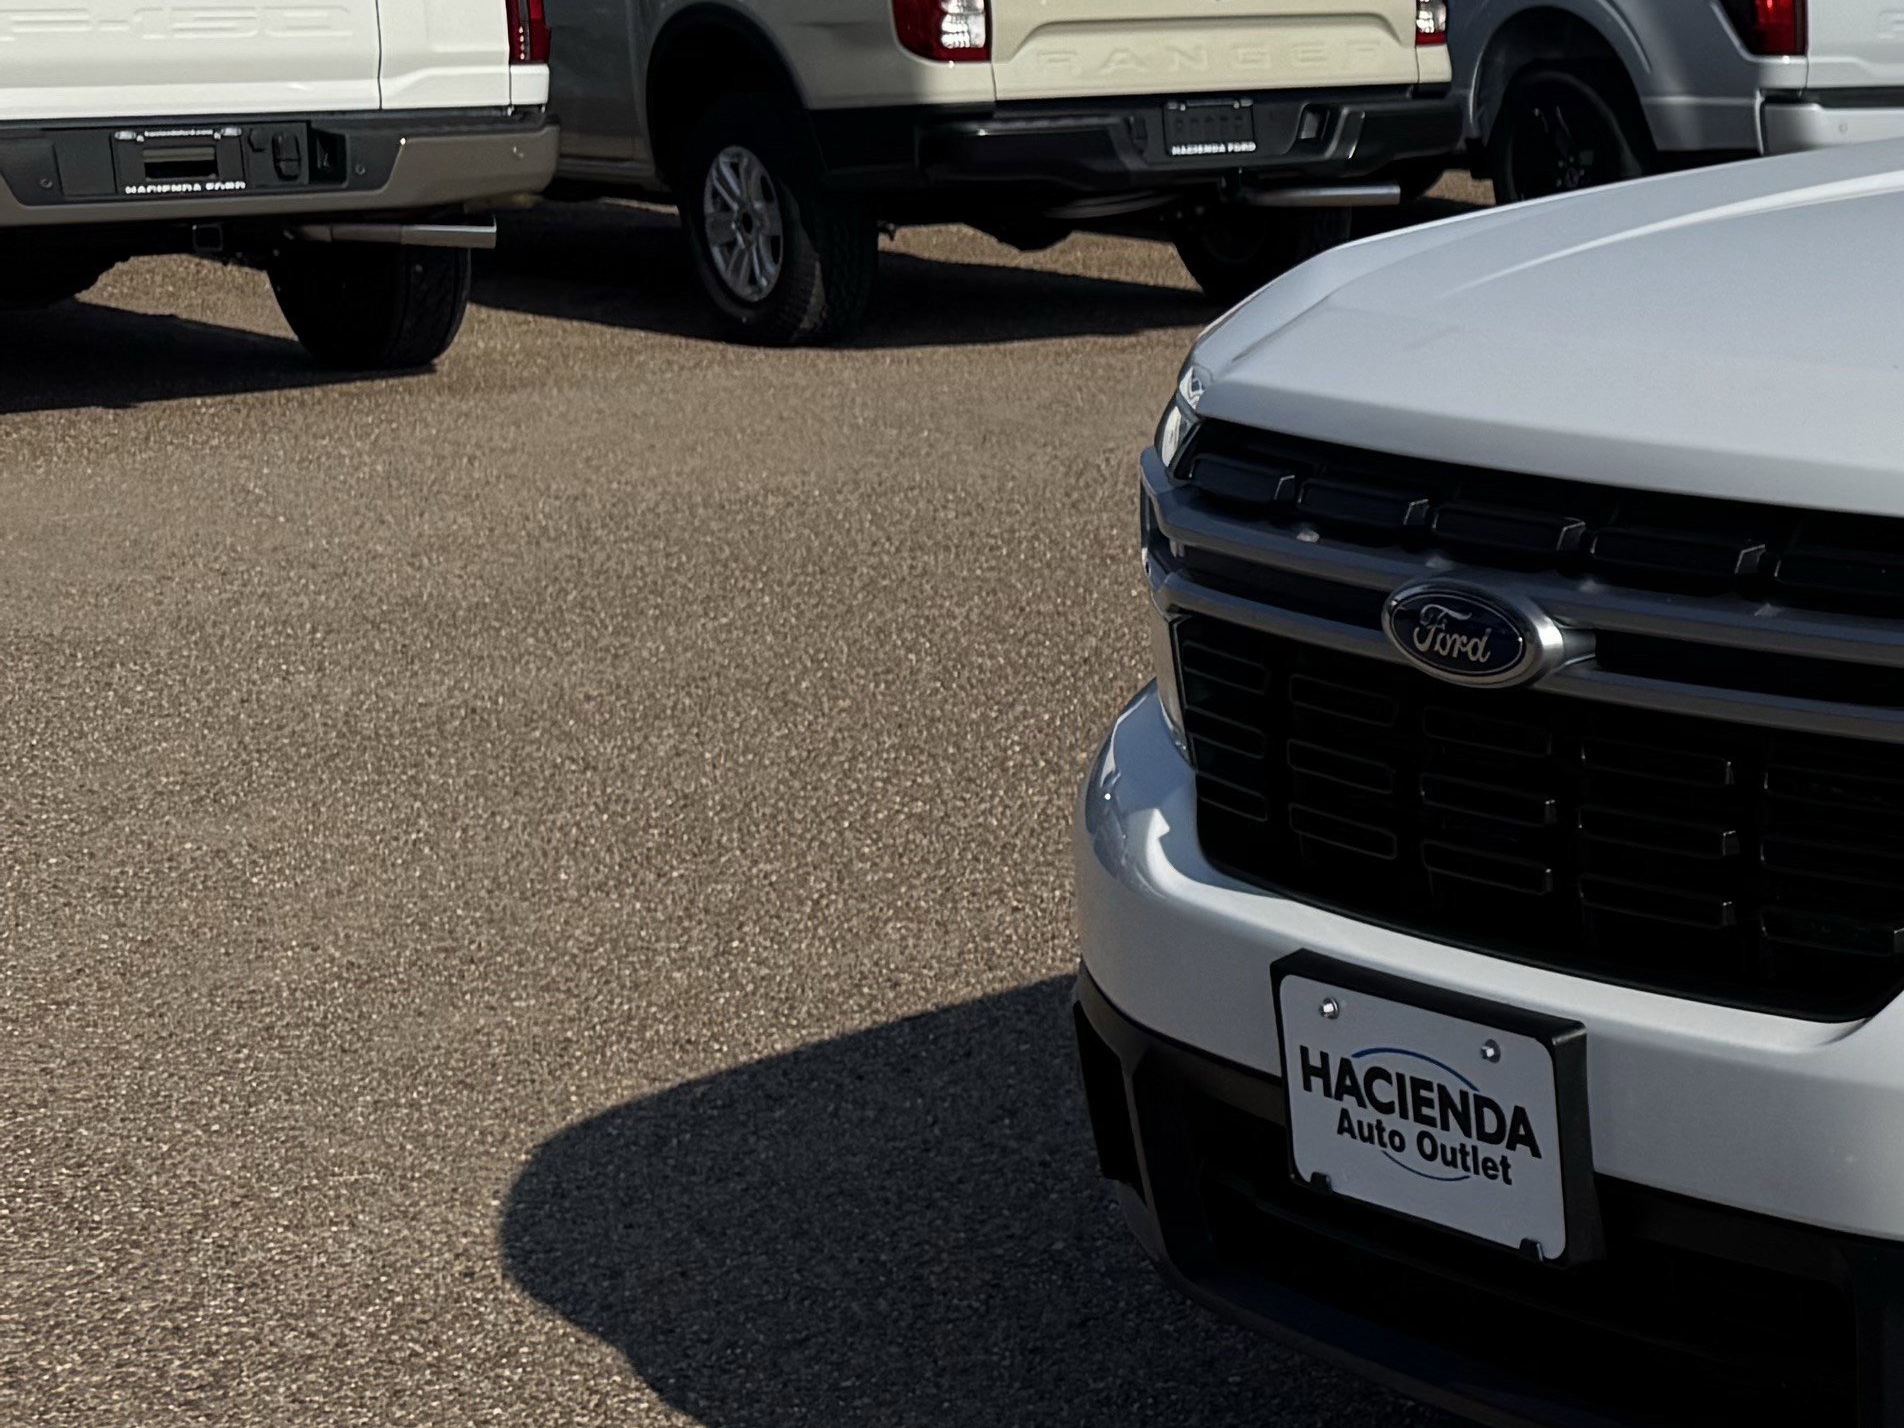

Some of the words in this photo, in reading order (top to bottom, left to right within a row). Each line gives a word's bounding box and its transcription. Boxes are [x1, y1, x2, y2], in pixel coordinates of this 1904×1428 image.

[1038, 40, 1382, 75] RANGER
[1411, 602, 1491, 664] Ford
[1300, 1045, 1542, 1159] HACIENDA
[1337, 1108, 1406, 1153] Auto
[1417, 1131, 1512, 1185] Outlet
